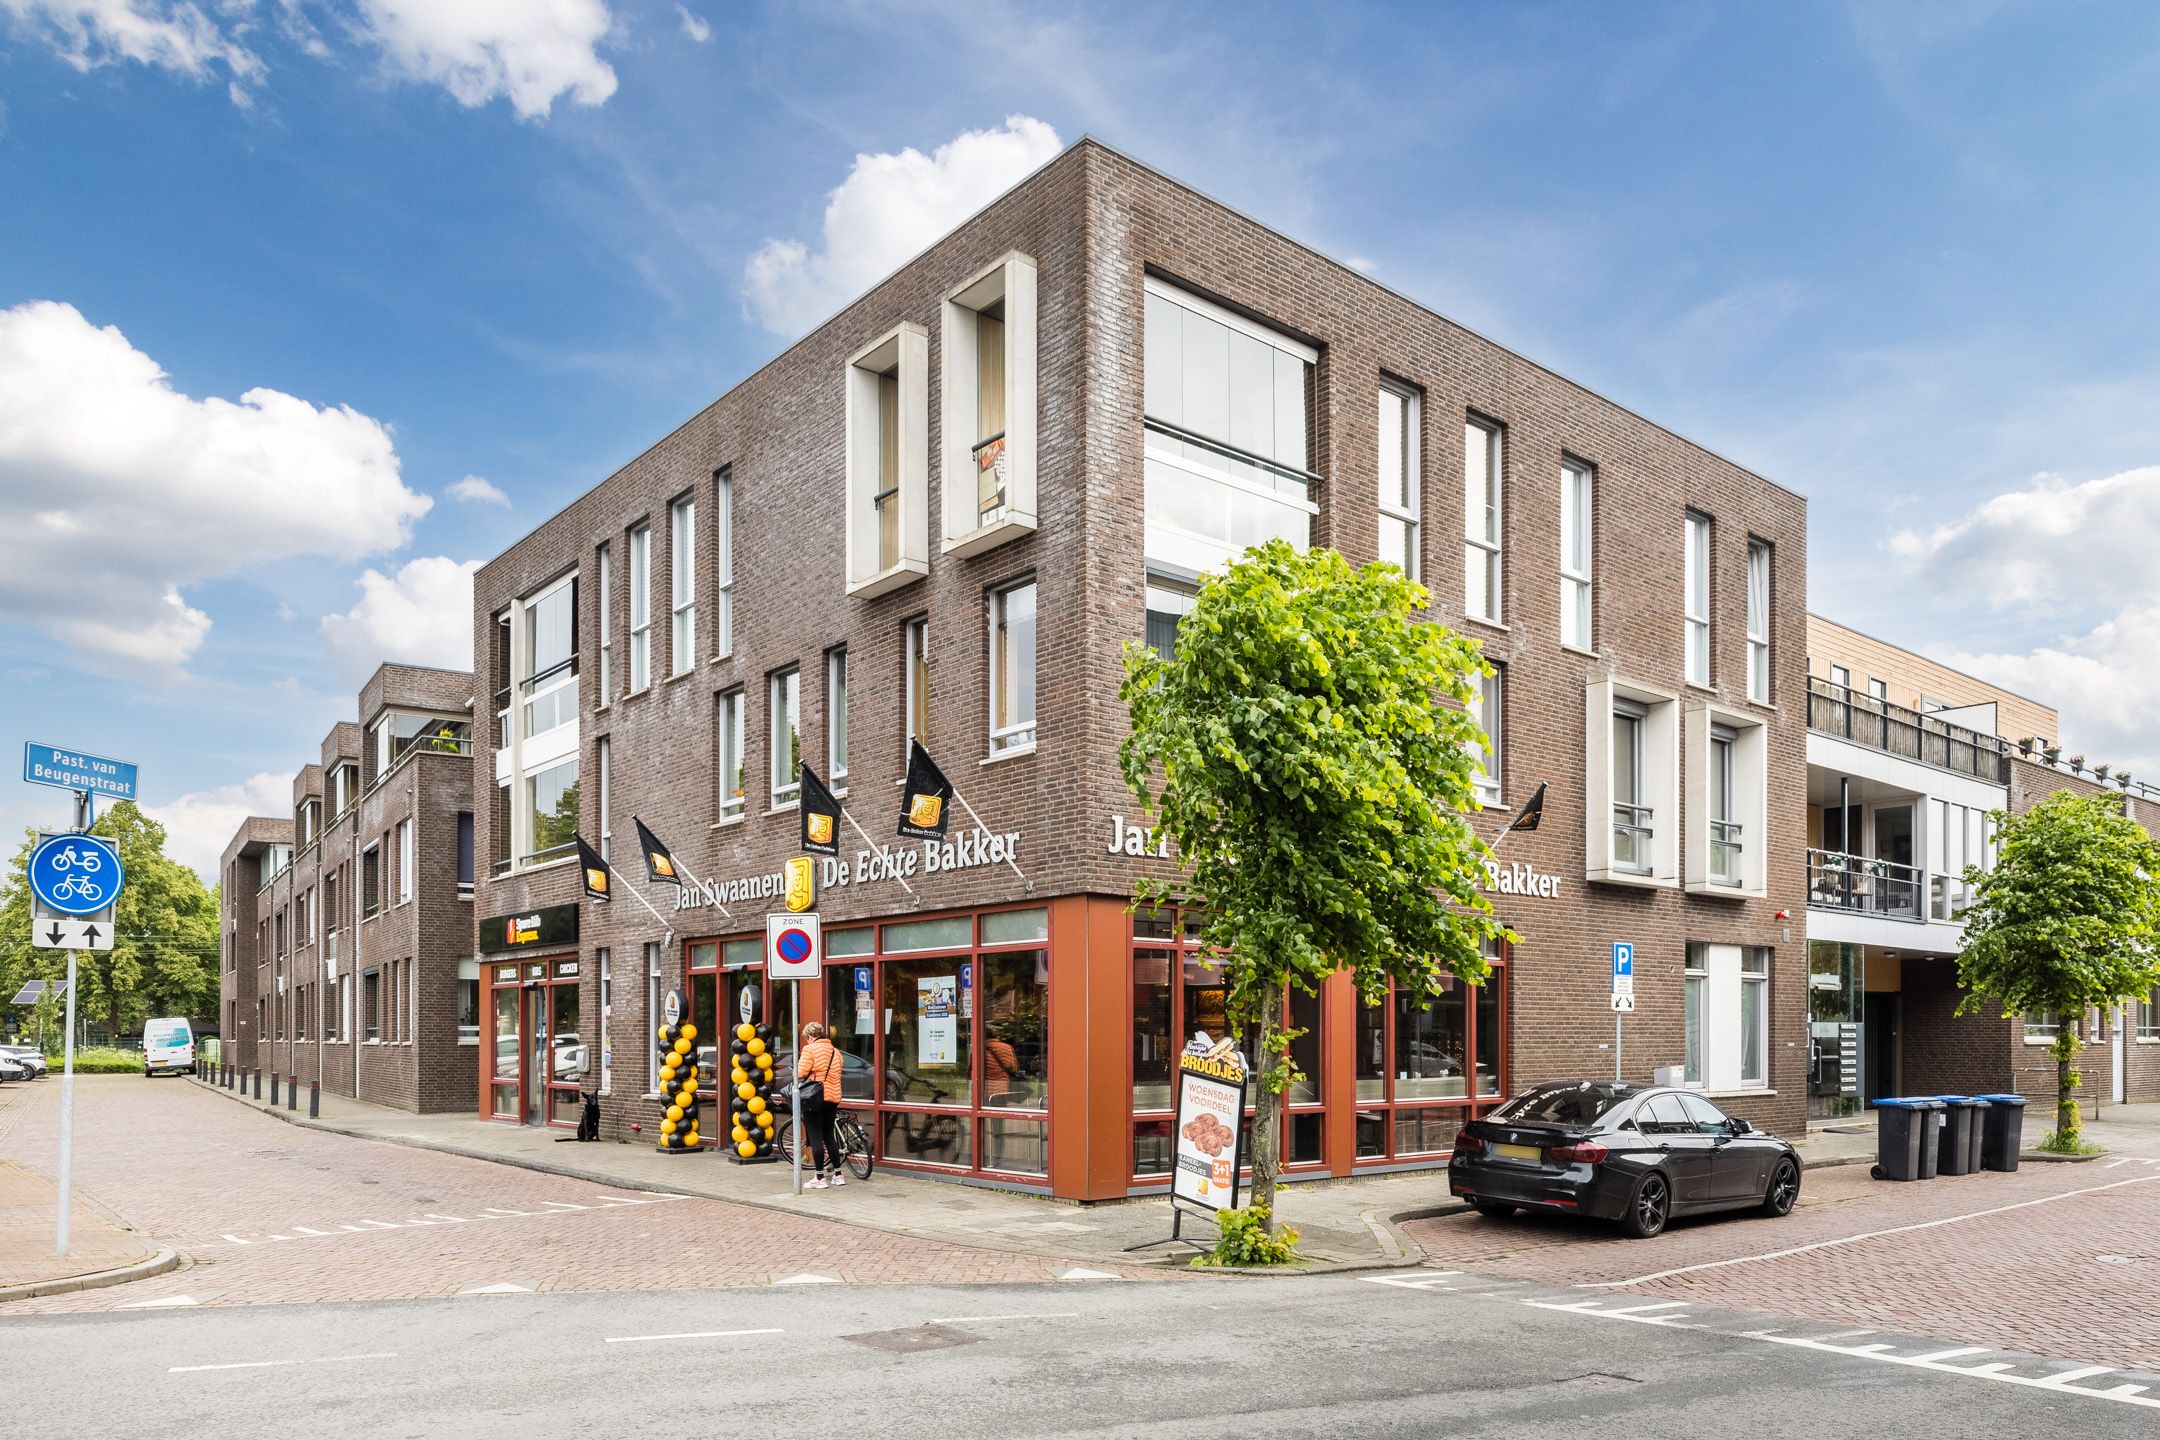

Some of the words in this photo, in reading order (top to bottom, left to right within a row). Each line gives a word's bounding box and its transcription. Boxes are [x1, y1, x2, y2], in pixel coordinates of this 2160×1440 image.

[53, 750, 88, 769] Past.
[92, 761, 116, 775] van
[34, 763, 131, 793] Beugenstraat
[822, 856, 849, 889] De
[855, 845, 918, 883] Echte
[923, 828, 1020, 874] Bakker
[674, 884, 701, 911] Jan
[704, 872, 785, 906] Swaanen
[1484, 861, 1561, 898] Bakker
[1618, 947, 1630, 972] P
[1181, 1054, 1244, 1083] BROODJES
[1188, 1082, 1235, 1104] WOENSDAG
[1189, 1095, 1232, 1115] VOORDEEL
[1178, 1160, 1207, 1176] BROODJES
[1213, 1162, 1229, 1177] 3+1
